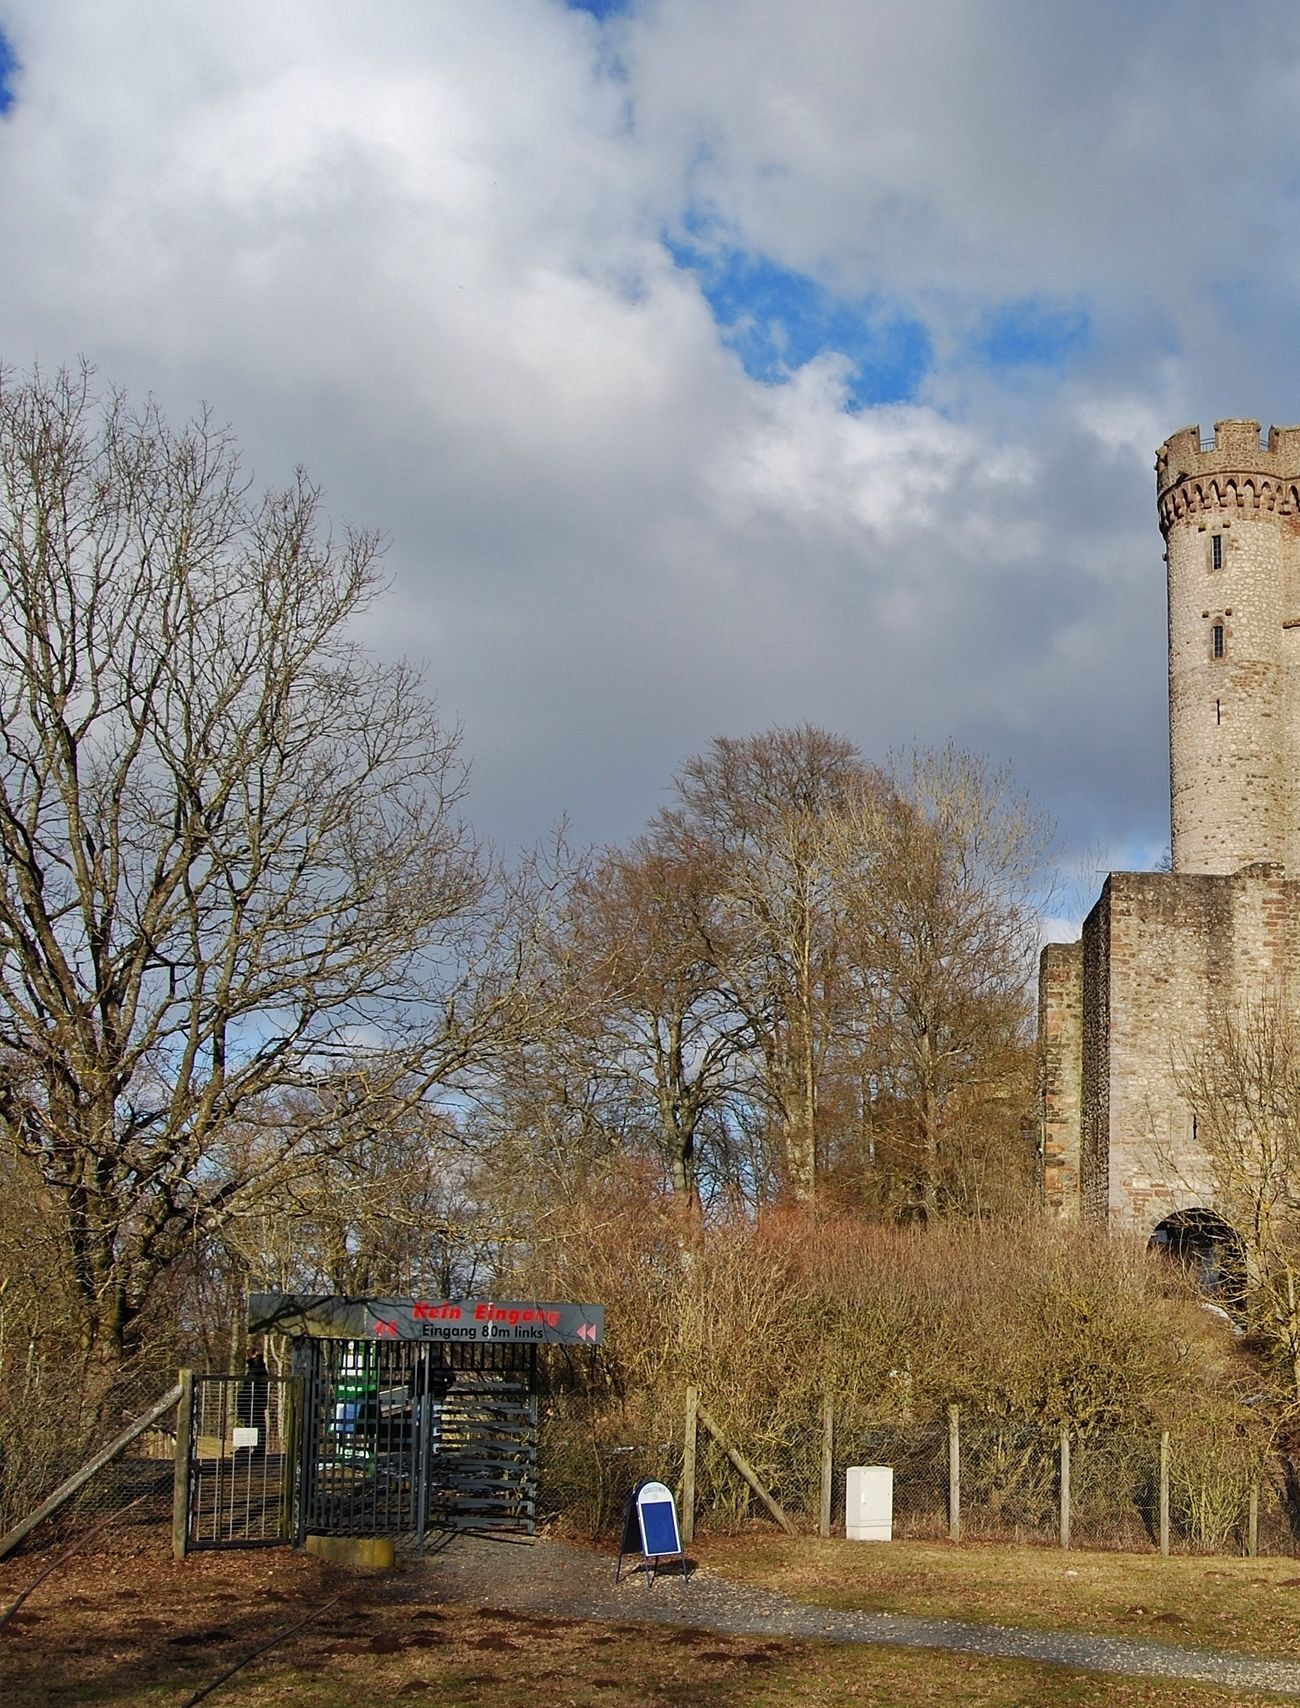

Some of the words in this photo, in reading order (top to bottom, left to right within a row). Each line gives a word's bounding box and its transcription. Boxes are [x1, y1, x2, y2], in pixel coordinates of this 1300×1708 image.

[412, 1302, 461, 1319] Kein
[474, 1303, 560, 1326] Eingang
[422, 1324, 477, 1339] Eingang
[481, 1325, 510, 1338] 80m
[514, 1325, 544, 1339] links
